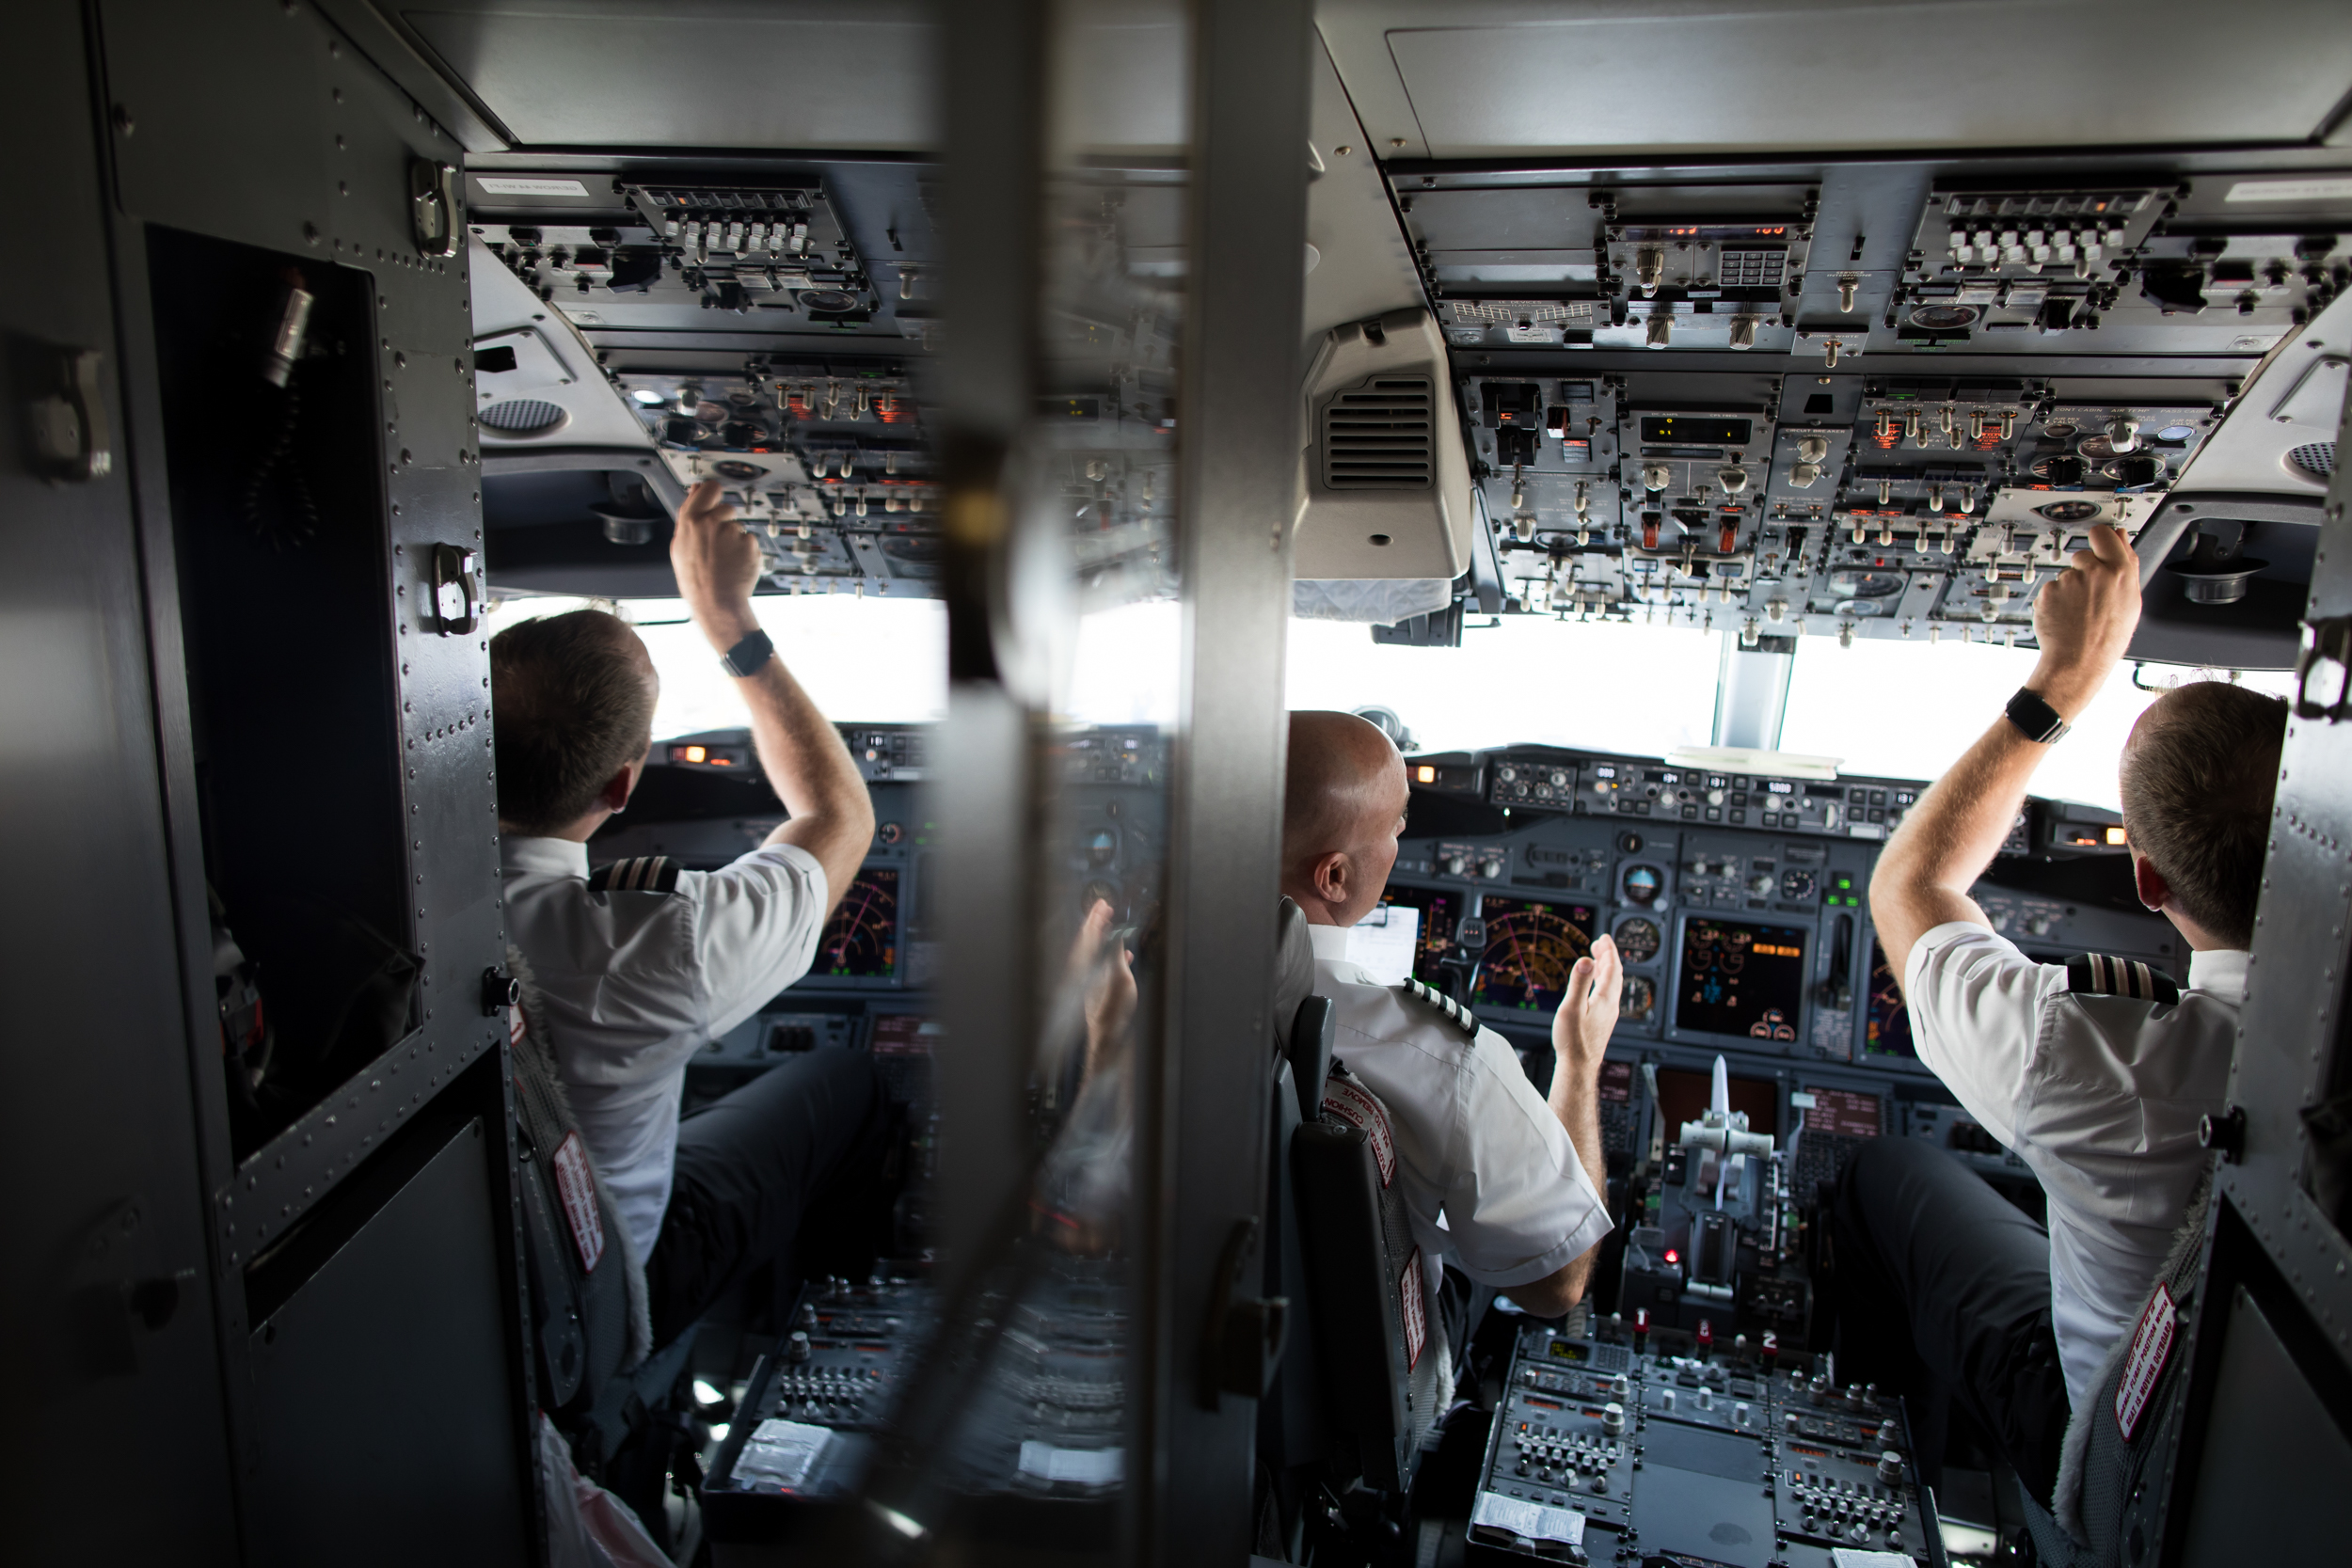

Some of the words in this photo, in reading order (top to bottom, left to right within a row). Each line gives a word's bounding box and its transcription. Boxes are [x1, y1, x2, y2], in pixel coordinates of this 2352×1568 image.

[1324, 1097, 1364, 1125] CUSHION
[1342, 1087, 1374, 1115] REMOVE
[1375, 1114, 1383, 1129] TO
[1637, 1309, 1645, 1326] 1
[1763, 1330, 1777, 1349] 2
[2128, 1349, 2136, 1372] REST
[2135, 1326, 2145, 1351] MUST
[2145, 1314, 2151, 1327] BE
[2150, 1302, 2156, 1315] IN
[2119, 1389, 2132, 1422] NORMAL
[2130, 1360, 2143, 1390] FLIGHT
[2140, 1323, 2157, 1362] POSITION
[2155, 1299, 2169, 1324] WHEN
[2126, 1405, 2137, 1427] SEAT
[2135, 1395, 2142, 1408] IS
[2139, 1363, 2156, 1397] MOVING
[2153, 1320, 2172, 1364] OUTBOARD
